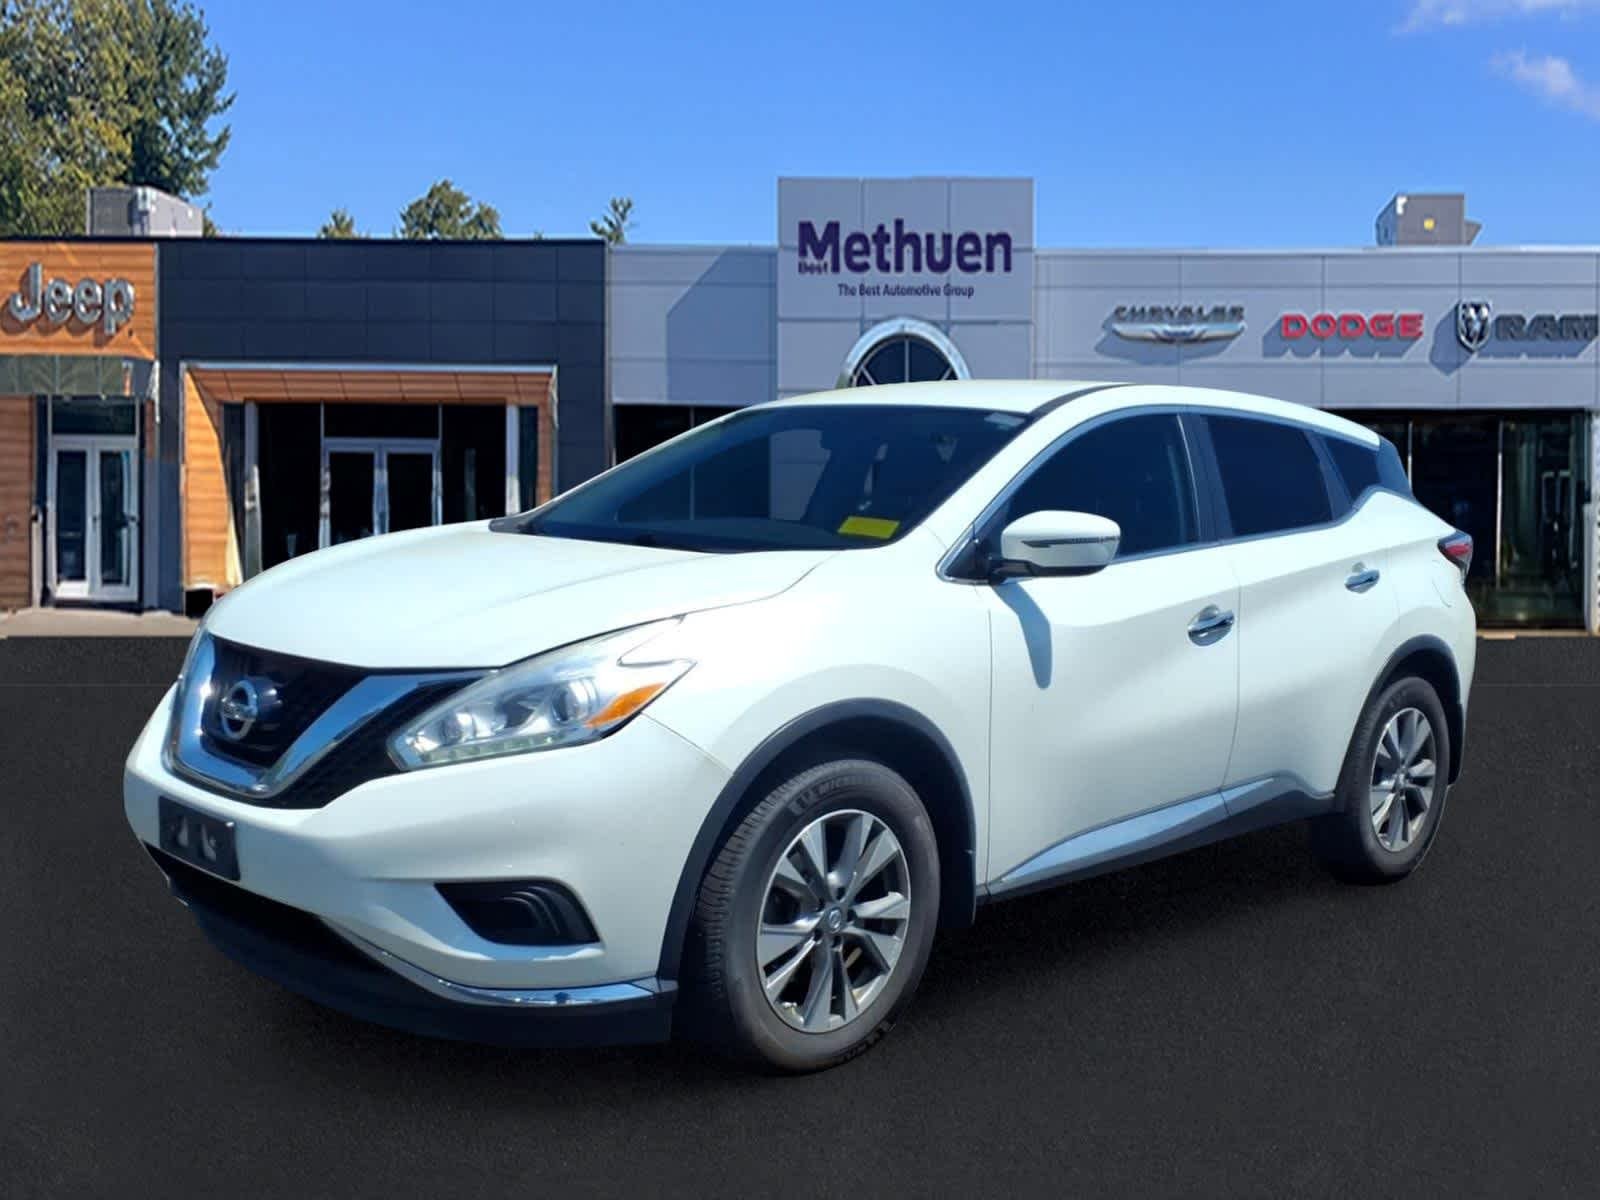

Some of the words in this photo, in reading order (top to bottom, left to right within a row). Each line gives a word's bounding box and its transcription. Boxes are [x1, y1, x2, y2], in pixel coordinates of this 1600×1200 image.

[798, 218, 1012, 273] Methuen
[10, 263, 135, 335] Jeep
[838, 283, 856, 297] The
[859, 283, 880, 297] Best
[882, 283, 941, 297] Automotive
[943, 283, 974, 298] Group
[1113, 304, 1245, 321] CHRYSLER
[1281, 312, 1424, 338] DODGE
[1494, 313, 1599, 341] RAM
